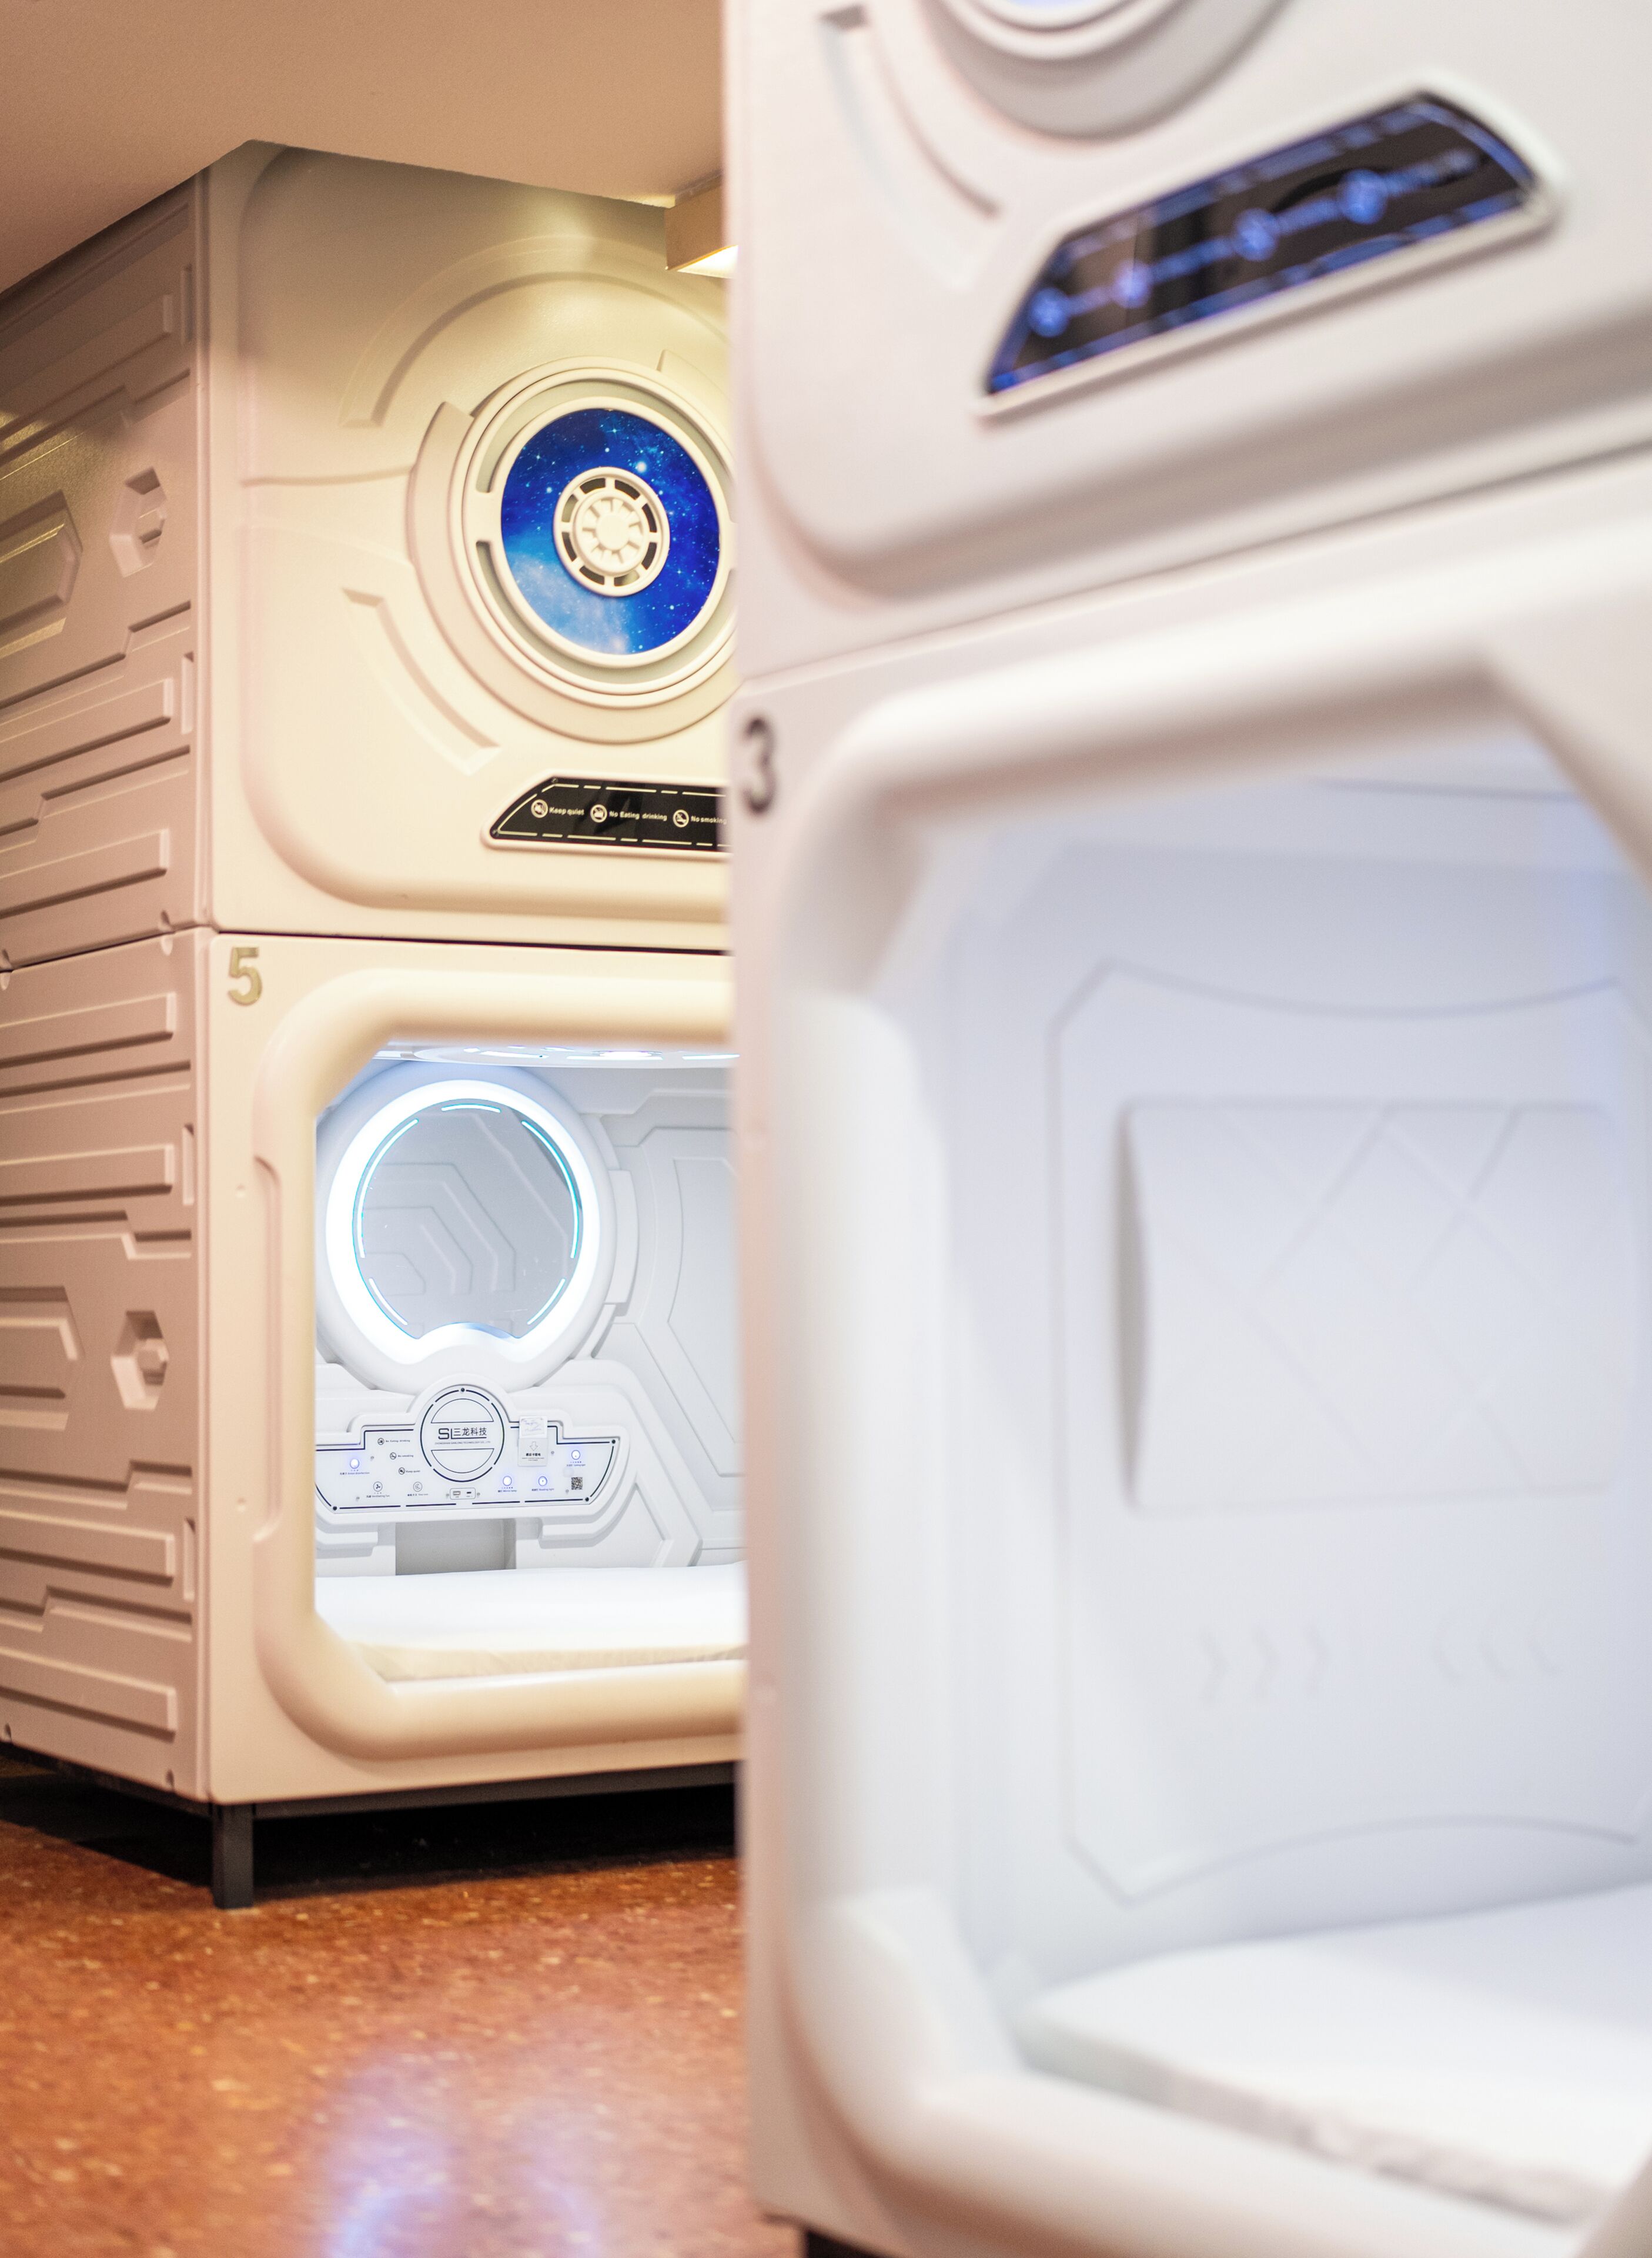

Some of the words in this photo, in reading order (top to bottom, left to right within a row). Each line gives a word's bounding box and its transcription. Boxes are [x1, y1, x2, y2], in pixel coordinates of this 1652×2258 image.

[741, 716, 778, 818] 3
[549, 807, 566, 816] Keep
[567, 808, 585, 816] quiet
[620, 811, 640, 820] Eating
[642, 813, 667, 822] drinking
[700, 817, 727, 825] smoking
[228, 947, 262, 1007] 5
[453, 1427, 487, 1437] 三龙科技
